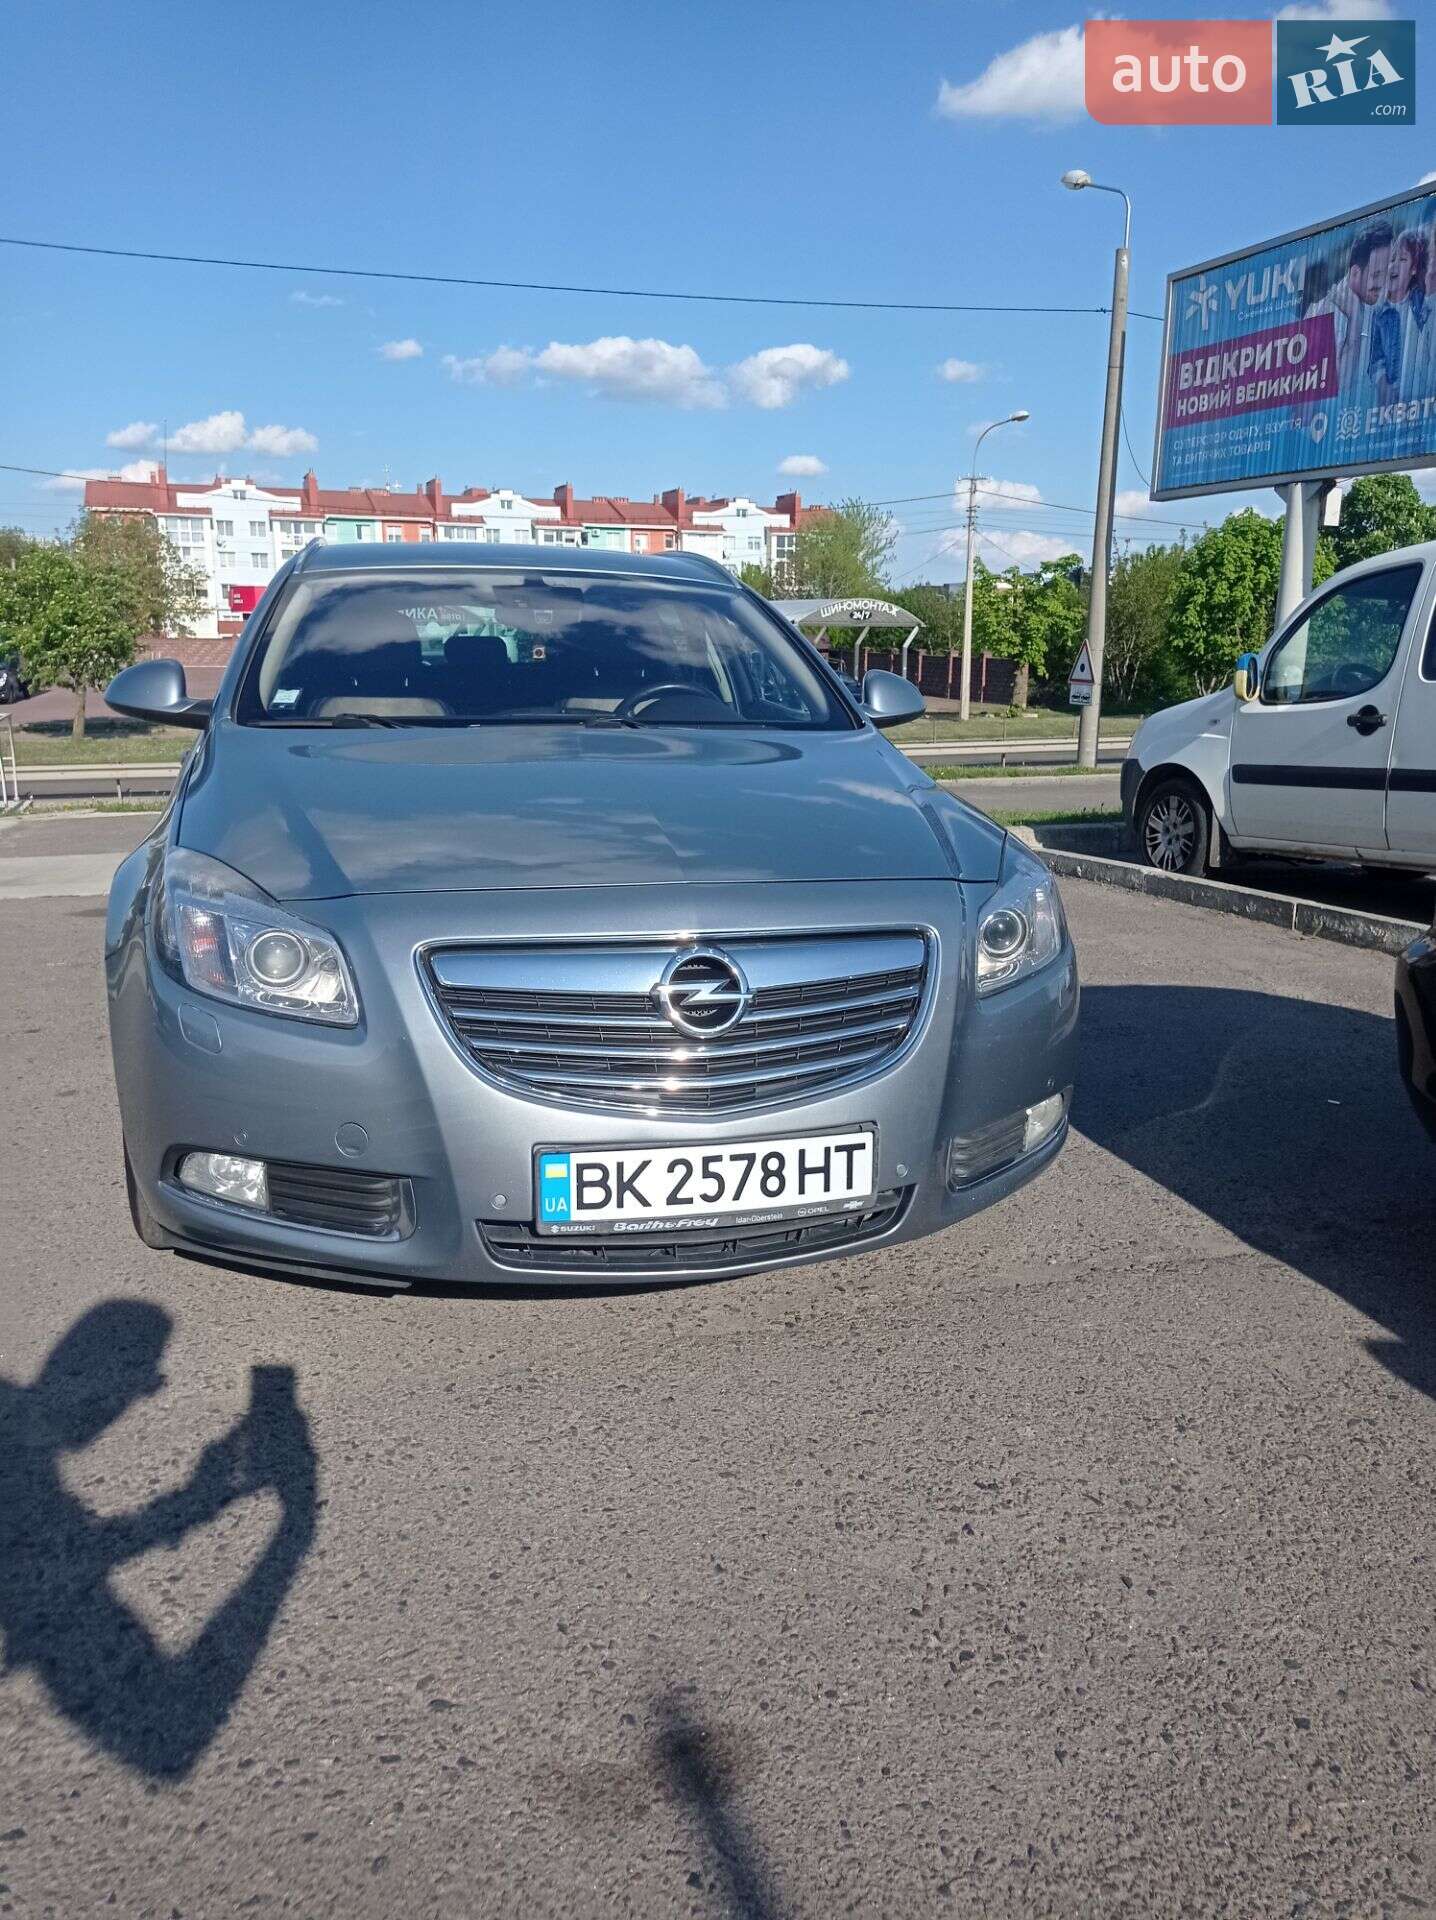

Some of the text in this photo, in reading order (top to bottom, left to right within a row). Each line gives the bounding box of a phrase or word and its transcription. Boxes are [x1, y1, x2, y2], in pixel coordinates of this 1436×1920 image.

[1225, 256, 1307, 311] YUKI
[1179, 333, 1308, 391] ВІДКРИТО
[1176, 357, 1328, 418] НОВИЙ ВЕЛИКИЙ!
[820, 600, 898, 618] ШИНОМОНТАЖ
[853, 610, 871, 620] 24/7
[576, 1143, 866, 1210] BK 2578 HT
[545, 1197, 568, 1213] UA
[807, 1206, 830, 1214] OPEL
[560, 1225, 596, 1233] SUZUKI
